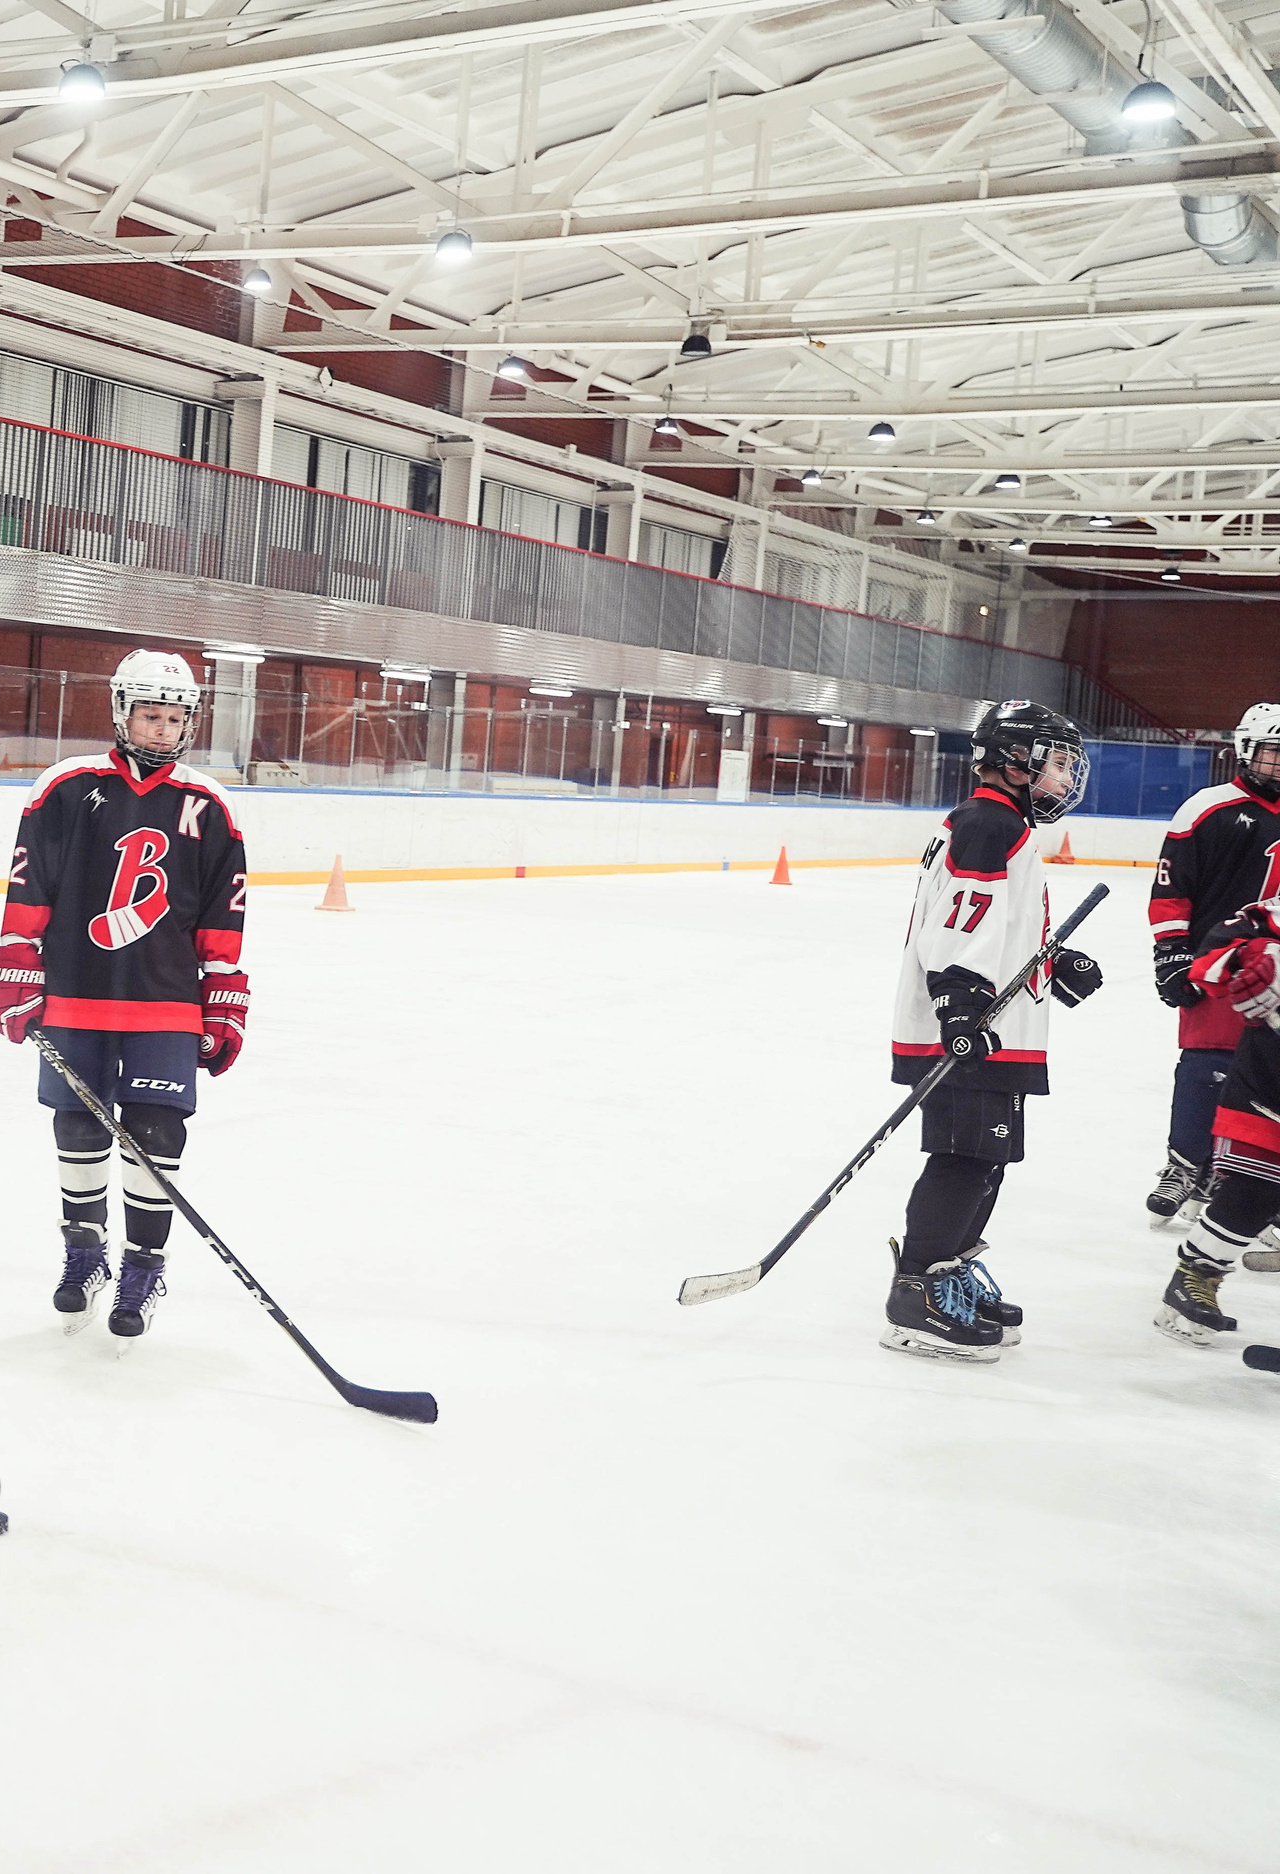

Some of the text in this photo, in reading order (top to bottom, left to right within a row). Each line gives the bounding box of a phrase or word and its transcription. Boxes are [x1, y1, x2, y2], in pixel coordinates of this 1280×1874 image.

[1000, 721, 1034, 730] BAUER
[943, 889, 994, 934] 17
[130, 1077, 187, 1094] CCM
